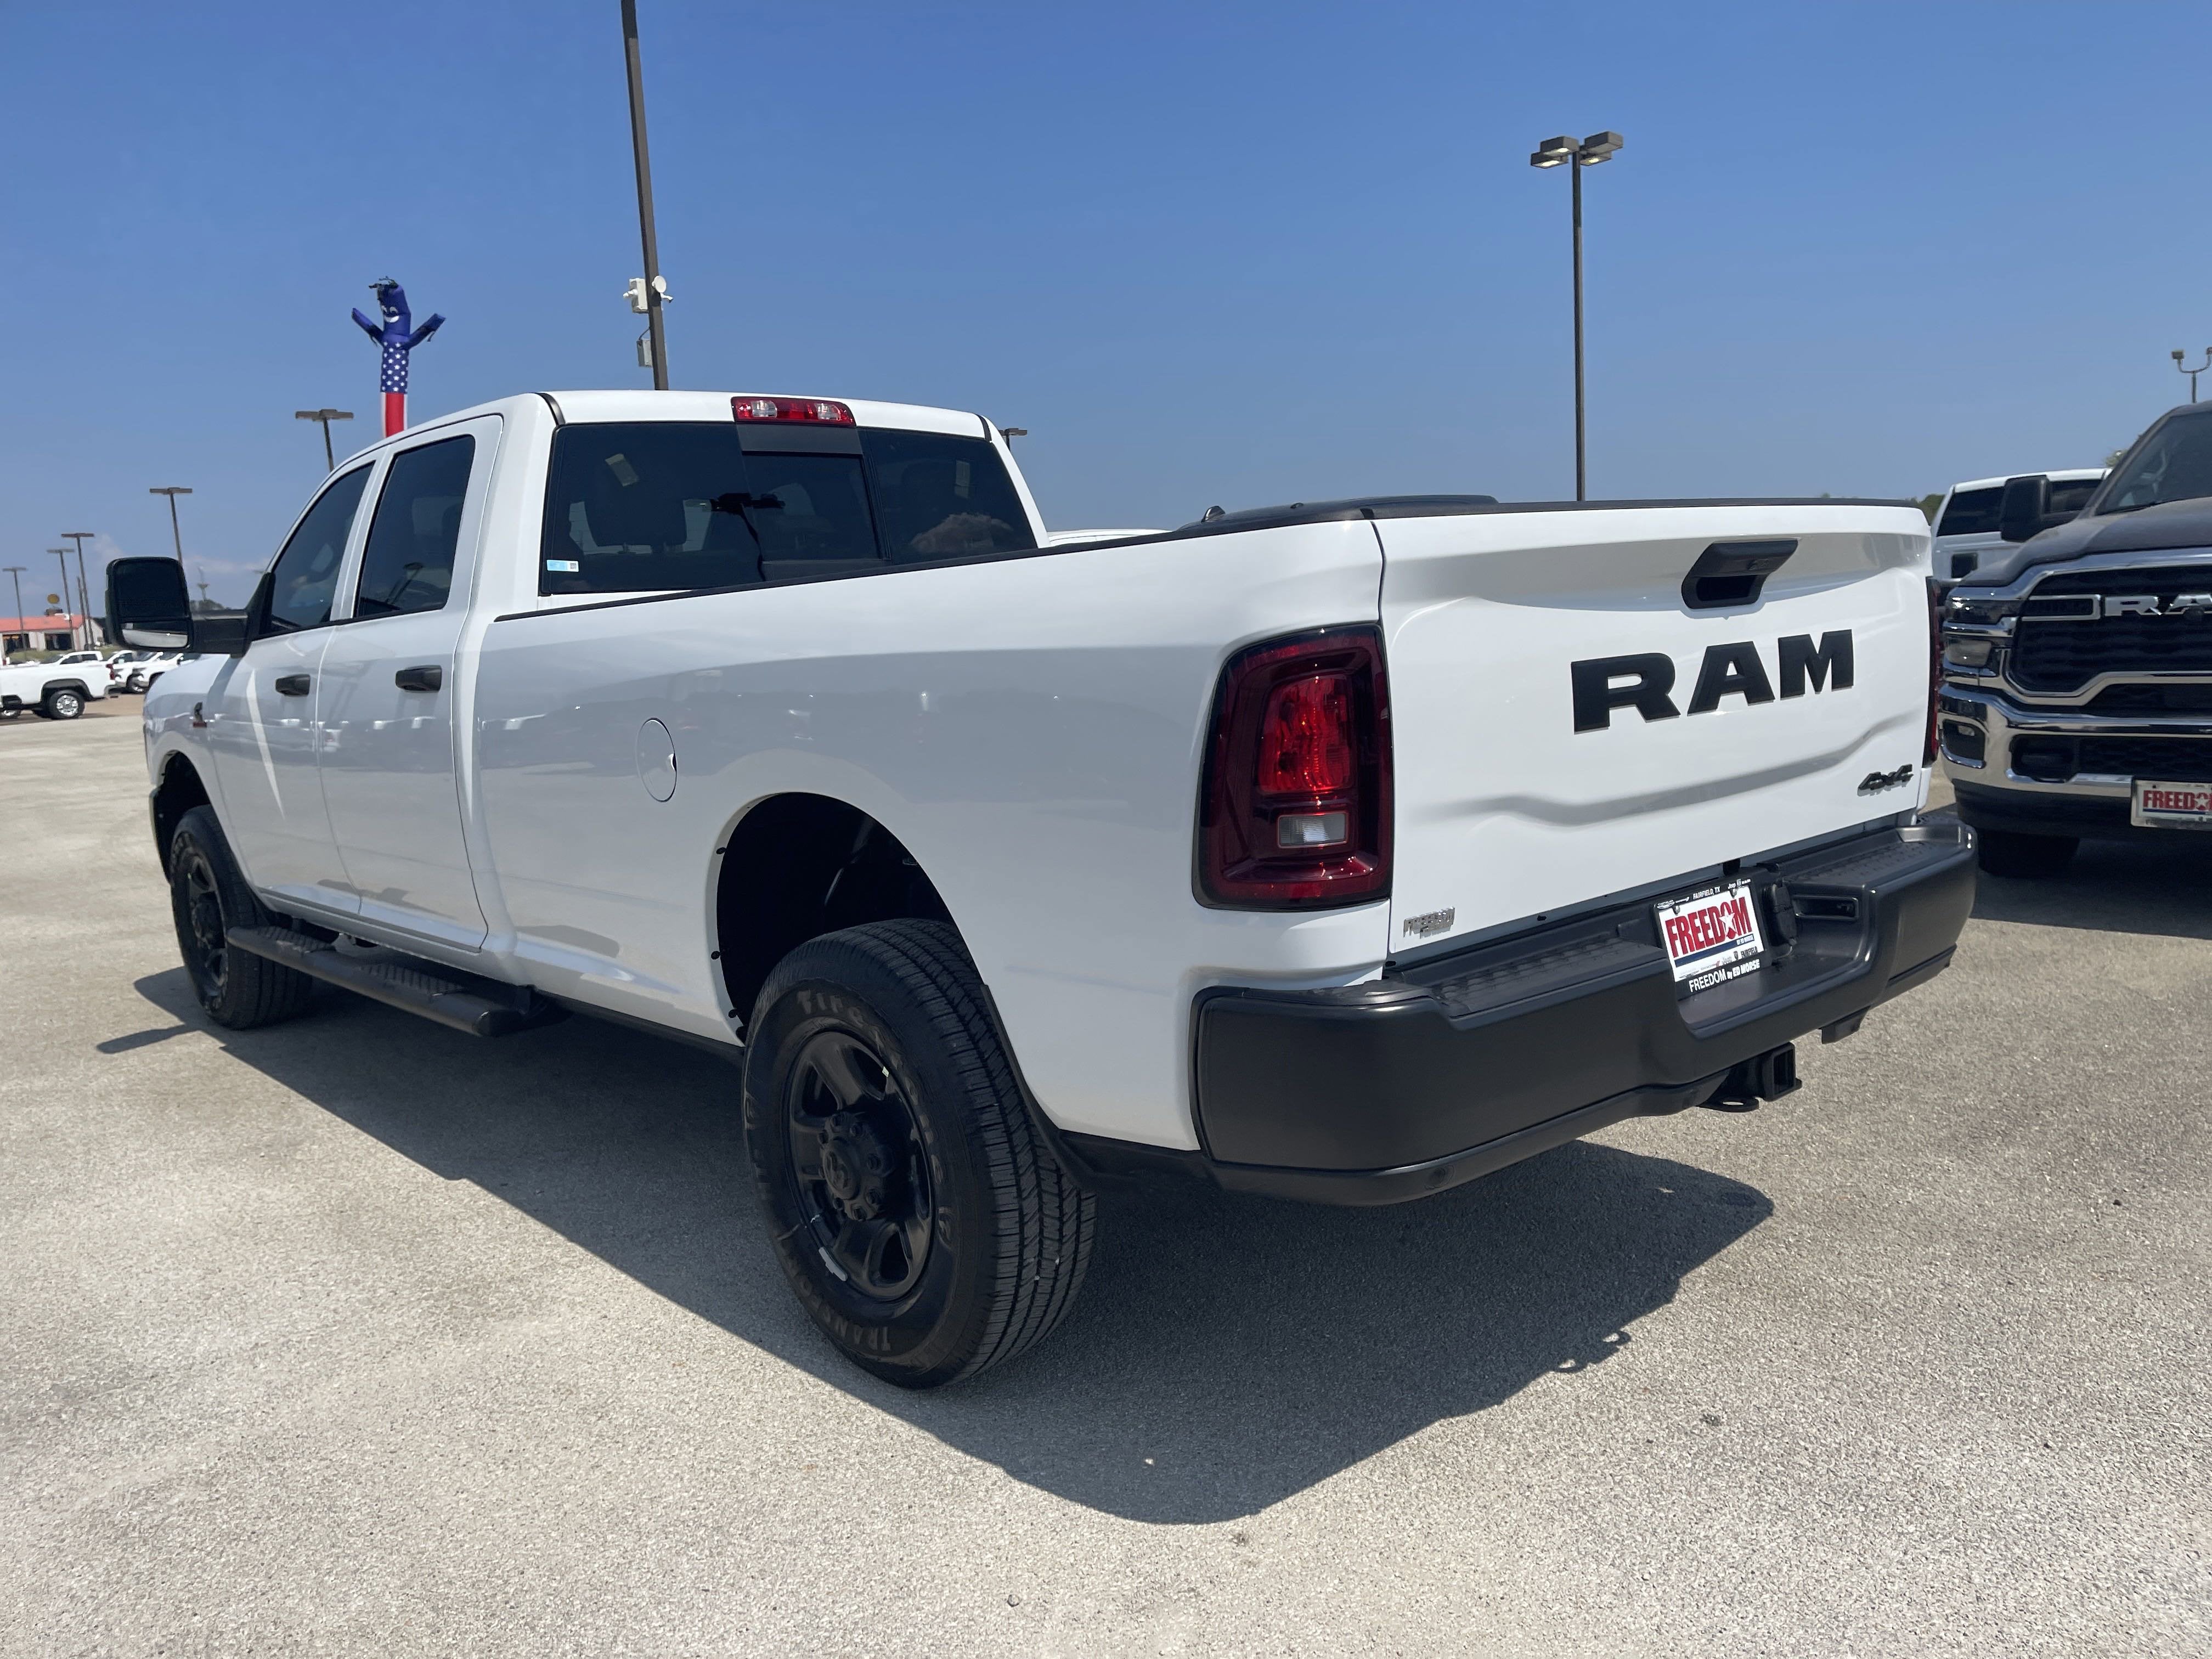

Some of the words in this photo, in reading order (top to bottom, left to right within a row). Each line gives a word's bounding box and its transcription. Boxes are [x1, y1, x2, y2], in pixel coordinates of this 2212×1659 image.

[1571, 629, 1854, 734] RAM
[1858, 764, 1914, 791] 4x4
[2143, 789, 2212, 811] FREEDO
[1665, 896, 1752, 958] FREEDOM
[1689, 968, 1727, 992] FREEDOM
[1733, 966, 1741, 977] ED
[1740, 958, 1760, 974] MORSE
